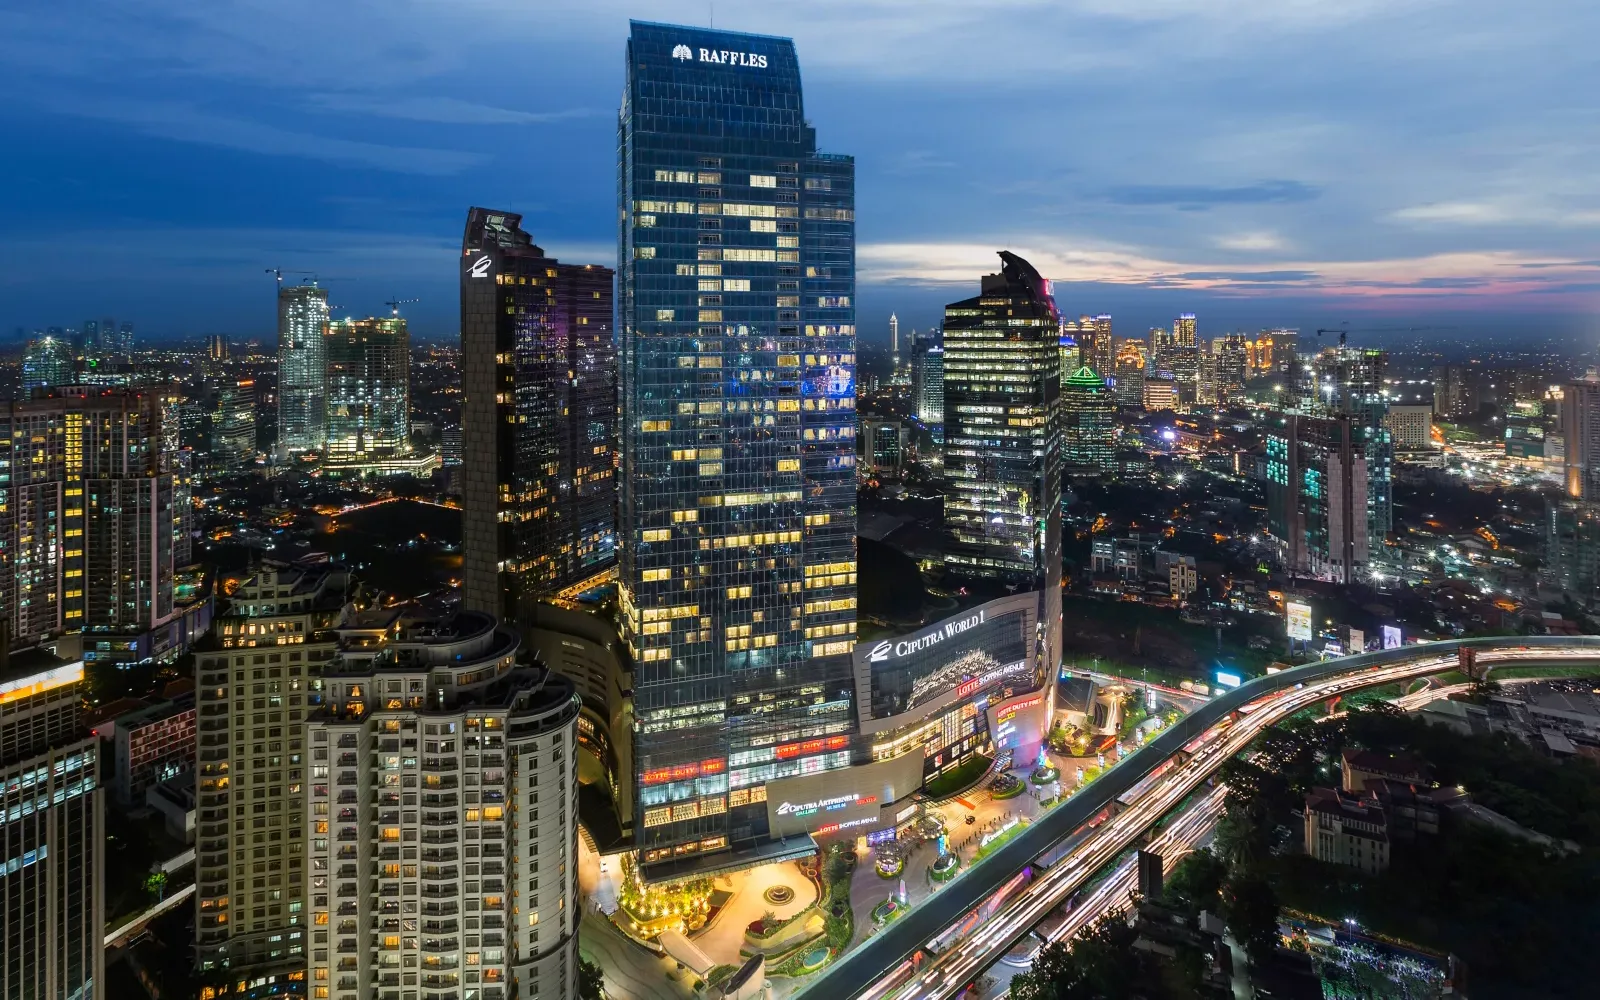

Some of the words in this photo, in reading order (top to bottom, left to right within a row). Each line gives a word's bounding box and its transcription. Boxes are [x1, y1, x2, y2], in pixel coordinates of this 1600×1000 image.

[699, 47, 768, 68] RAFFLES
[895, 630, 945, 657] CIPUTRA
[945, 615, 979, 638] WORLD
[958, 680, 979, 696] LOTTE
[979, 669, 1003, 686] SHOPPING
[1003, 661, 1025, 675] AVENUE
[1012, 701, 1029, 711] DUTY
[645, 771, 669, 781] LOTTE
[675, 767, 695, 776] DUTY
[789, 802, 818, 813] CIPUTRA
[820, 825, 838, 833] LOTTE
